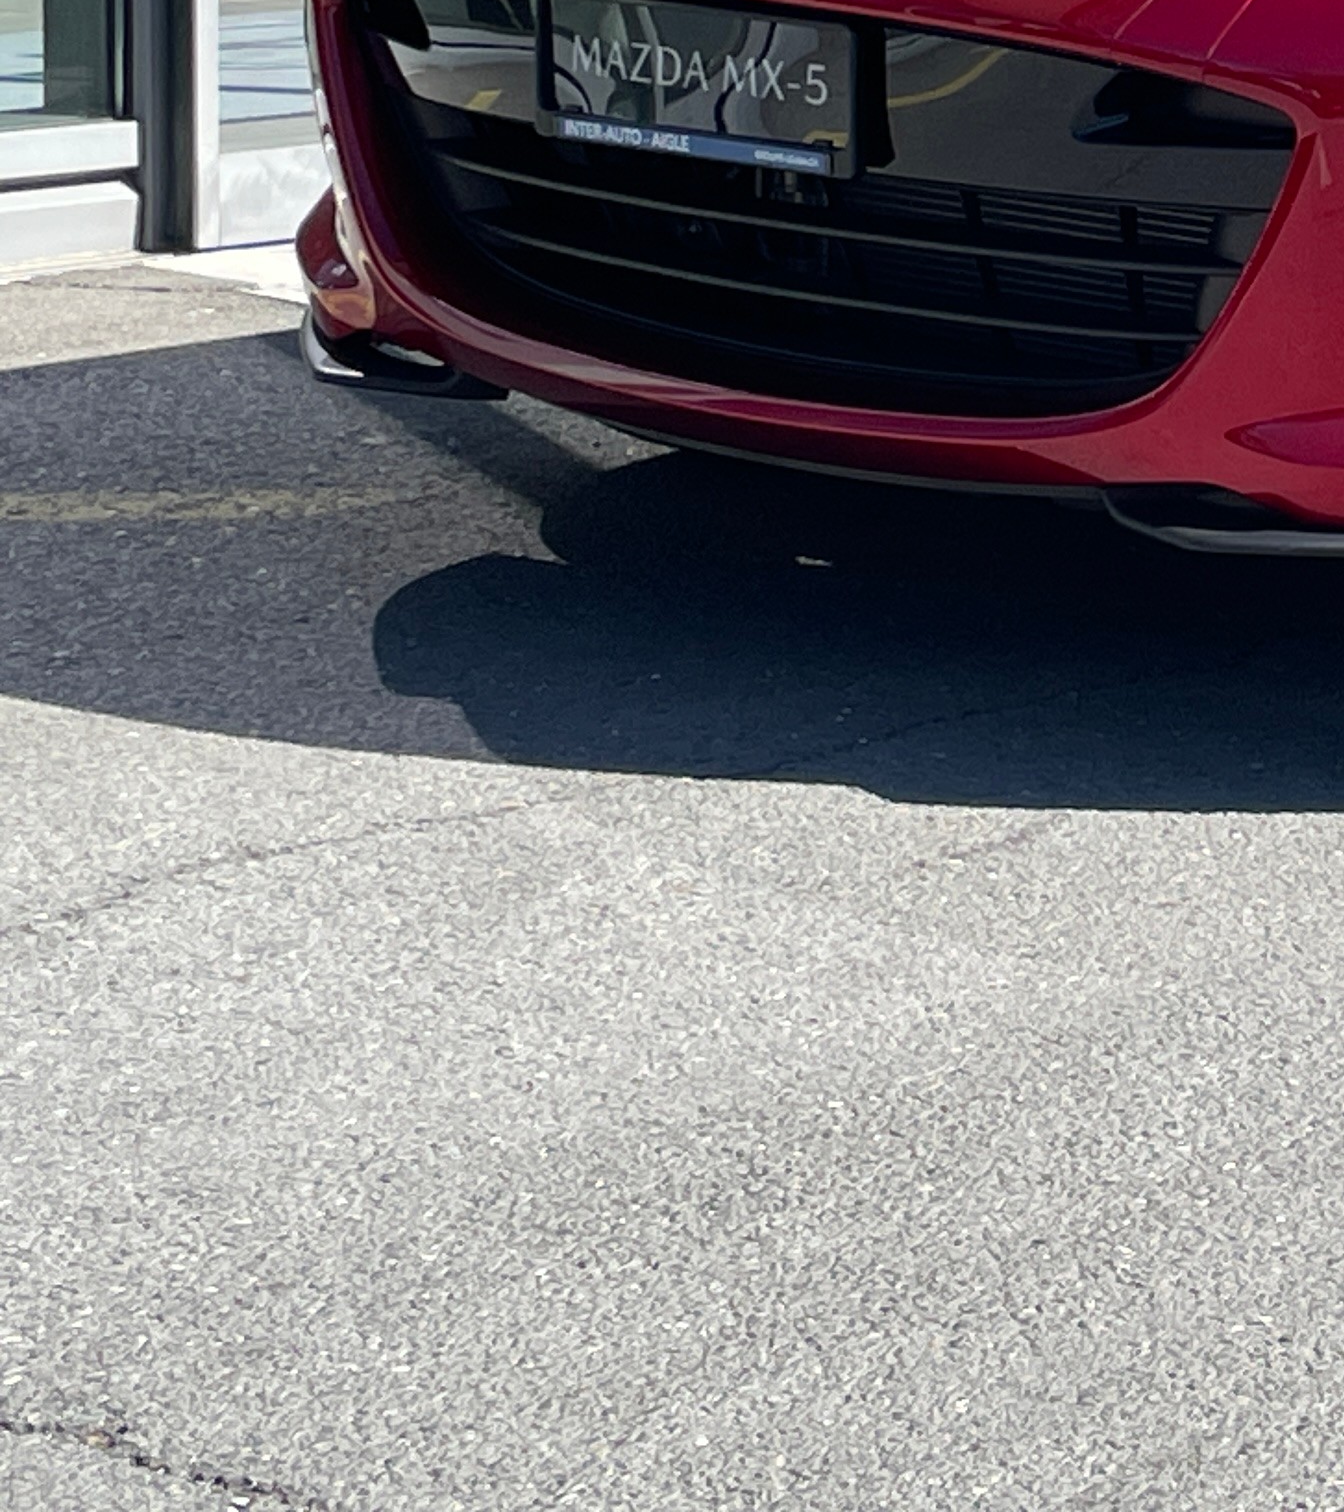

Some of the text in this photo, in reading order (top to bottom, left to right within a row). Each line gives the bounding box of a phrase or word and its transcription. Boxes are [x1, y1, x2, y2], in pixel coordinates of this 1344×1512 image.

[571, 34, 828, 105] MAZDA MX-5
[564, 120, 642, 146] INTER-AUTO
[651, 133, 690, 153] AIGLE
